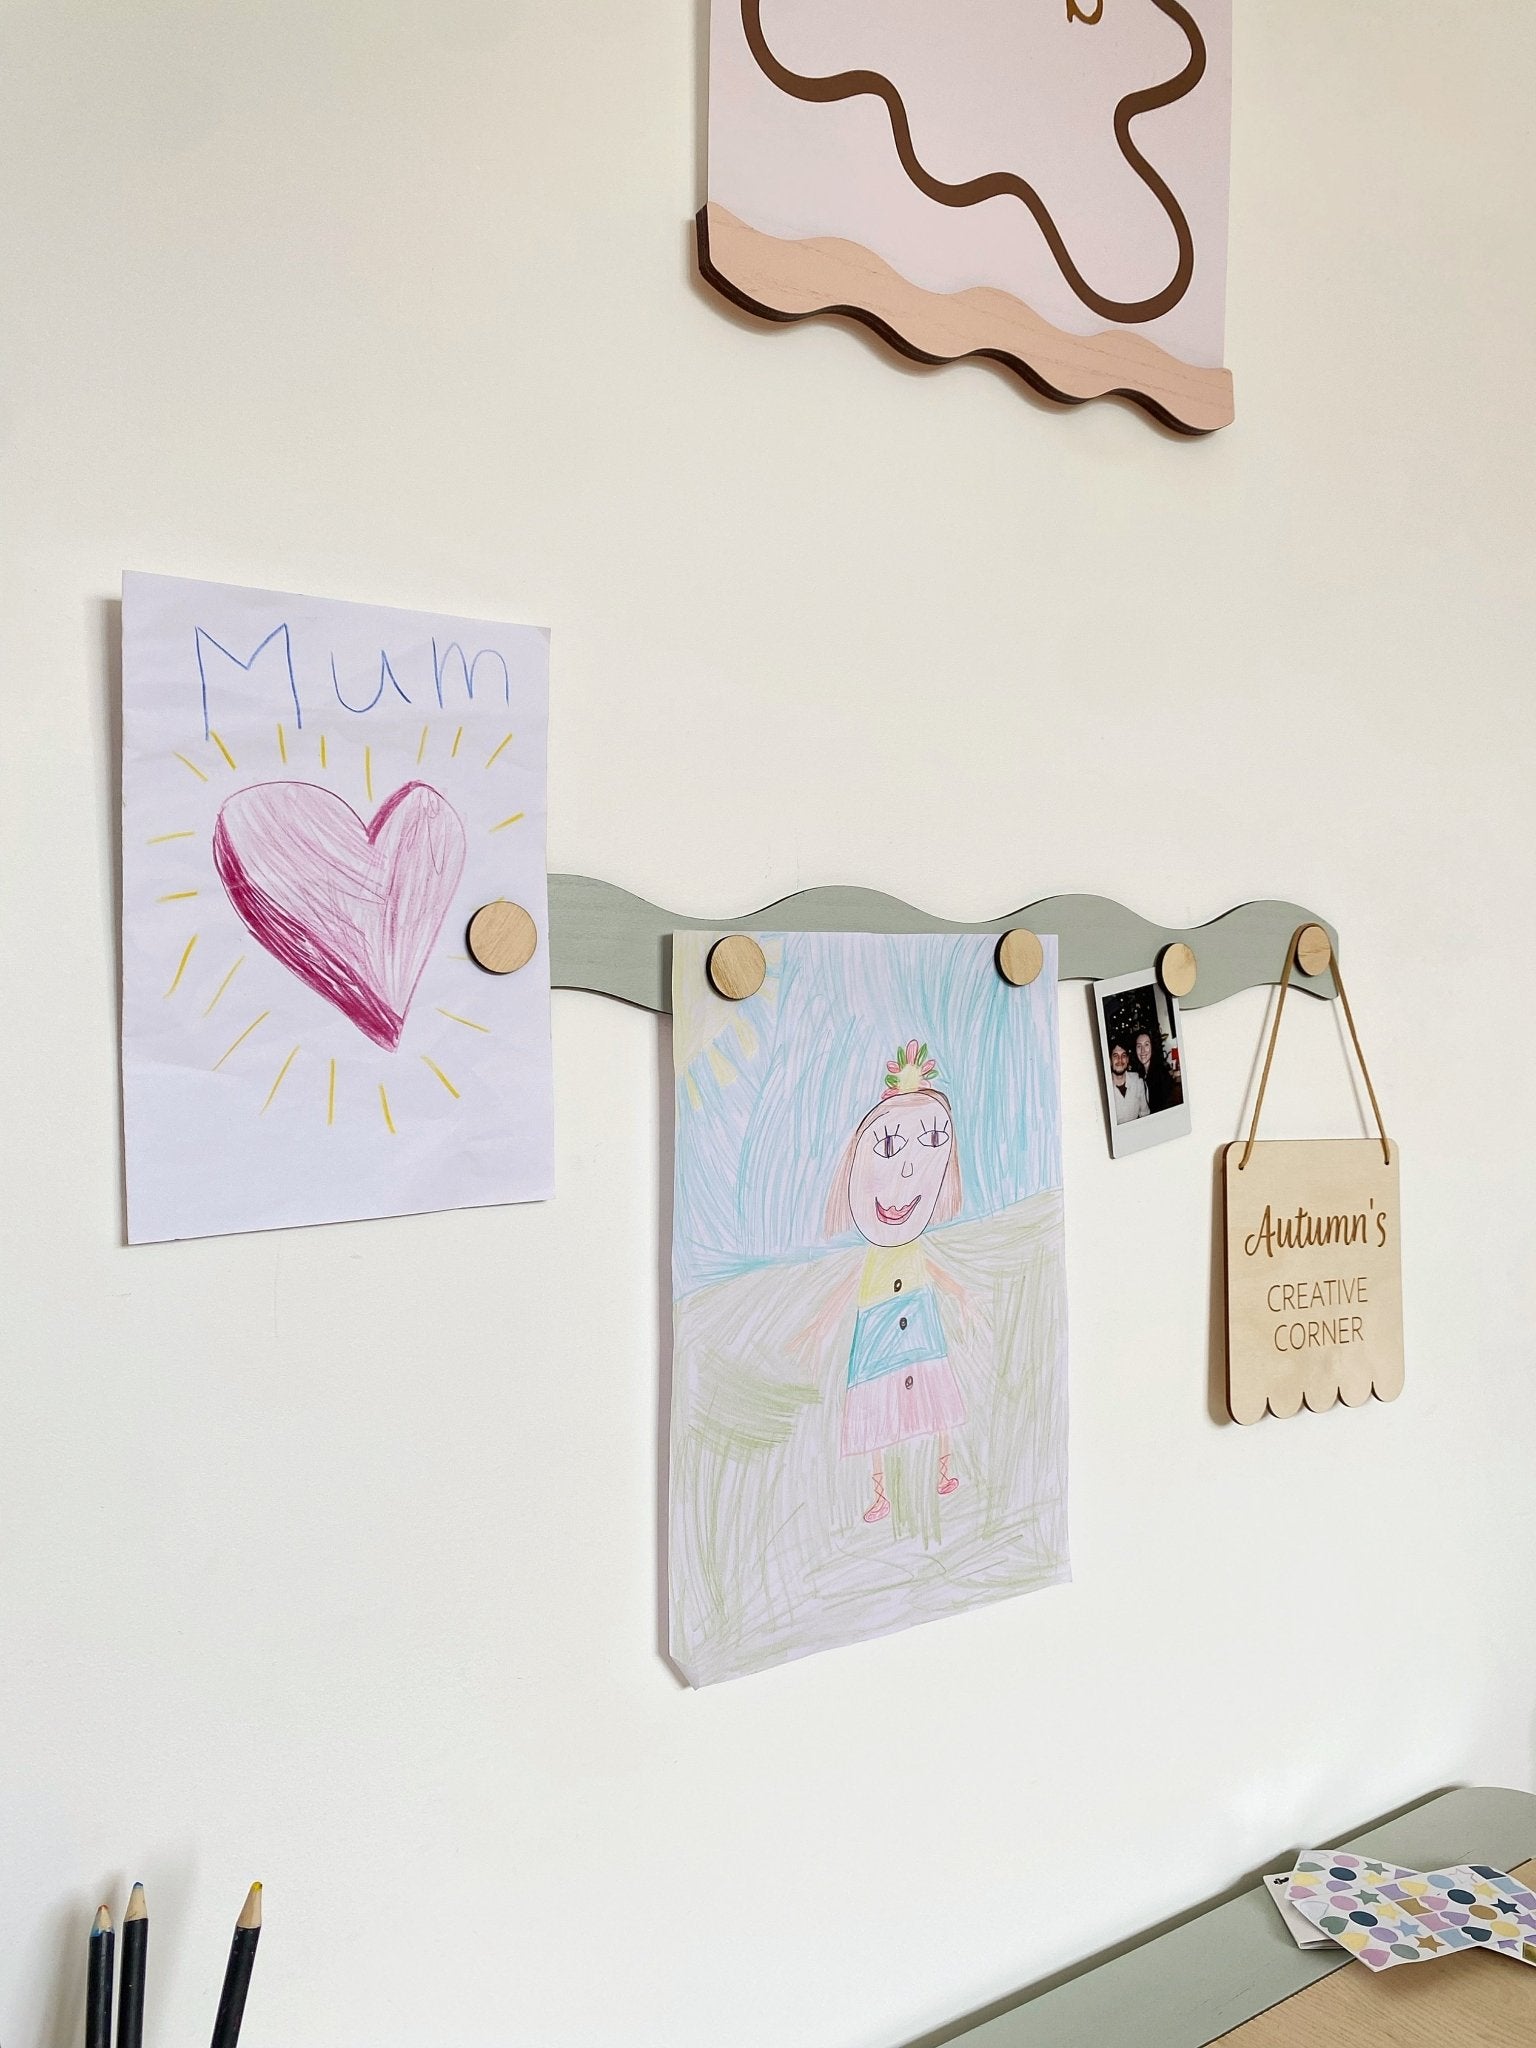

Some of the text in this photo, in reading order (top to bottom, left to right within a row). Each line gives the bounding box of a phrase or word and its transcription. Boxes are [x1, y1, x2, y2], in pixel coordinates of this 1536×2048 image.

[195, 622, 510, 742] Mum
[1244, 1197, 1387, 1258] Autumn's
[1267, 1276, 1369, 1313] CREATIVE
[1274, 1316, 1364, 1352] CORNER
